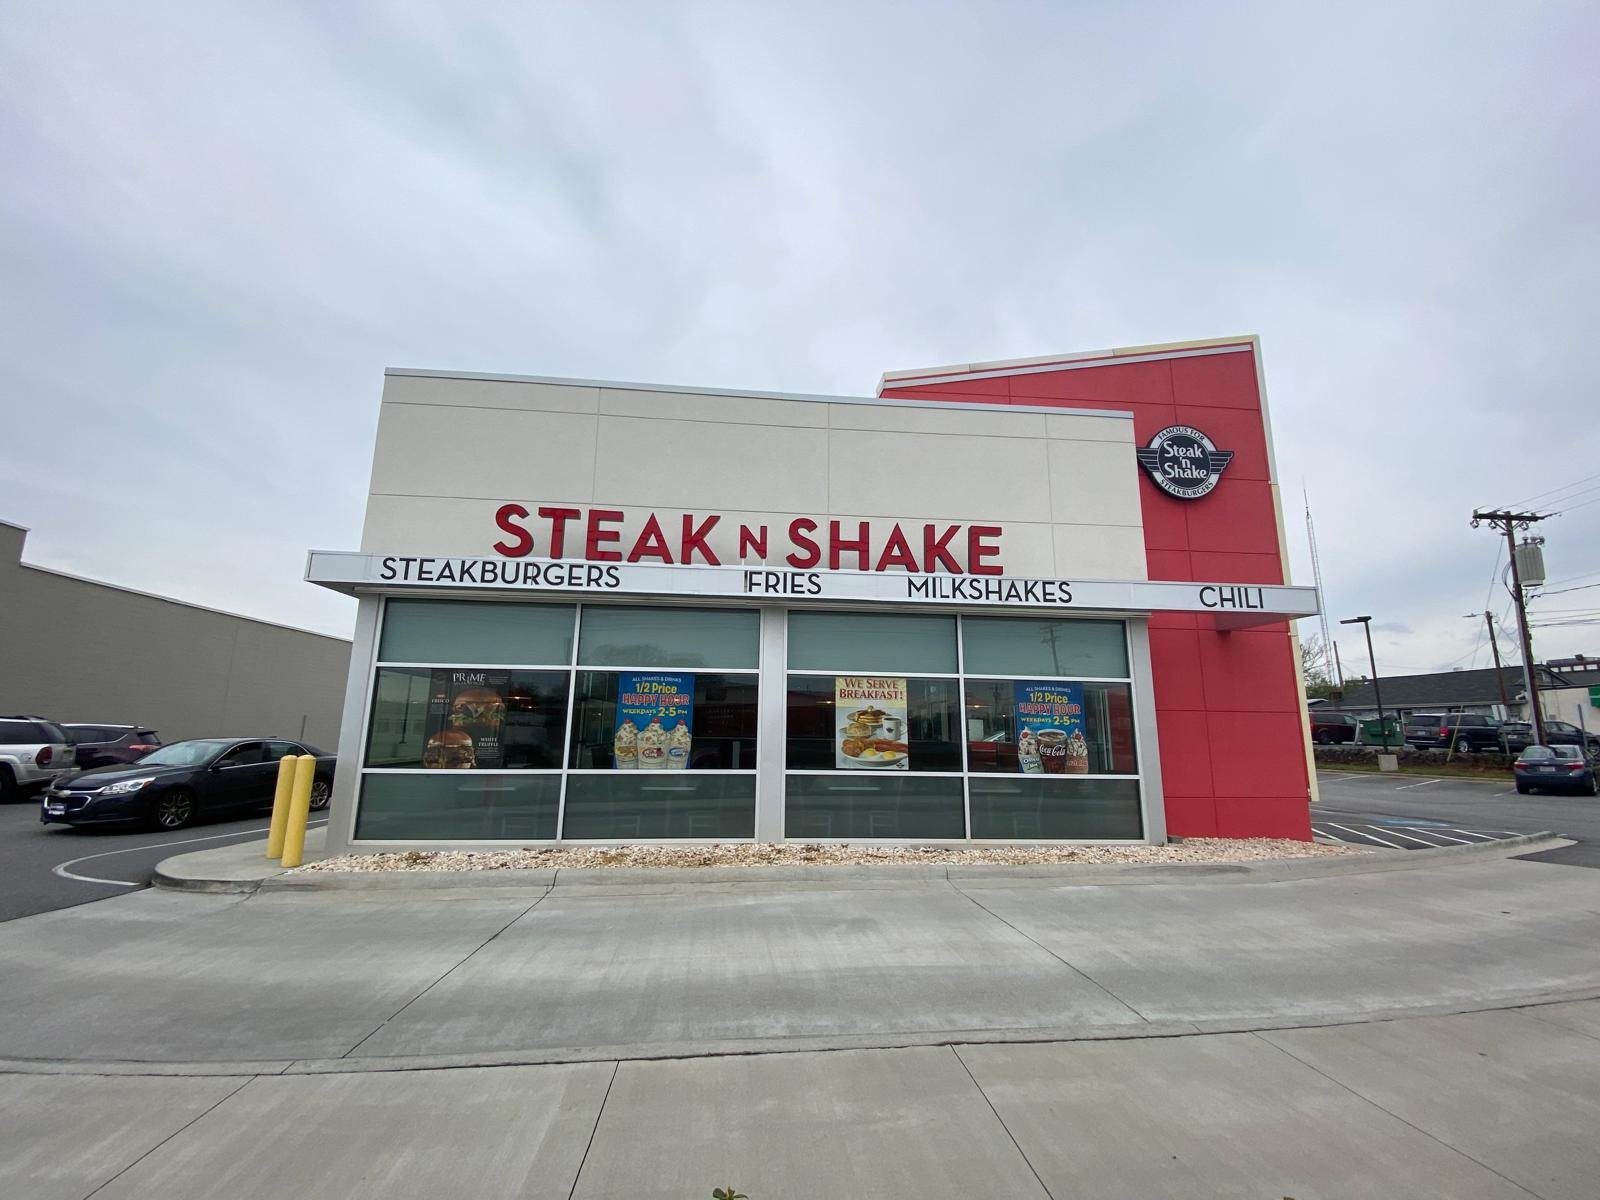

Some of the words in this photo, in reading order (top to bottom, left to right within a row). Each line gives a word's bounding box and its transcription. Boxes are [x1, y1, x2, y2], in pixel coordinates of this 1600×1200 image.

[1158, 427, 1189, 440] FAMOUS
[1190, 429, 1205, 441] FOR
[1163, 441, 1203, 458] Steak
[1164, 462, 1207, 479] Shake
[1160, 480, 1214, 497] STEAKBURGERS
[493, 503, 722, 566] STEAK
[739, 524, 768, 560] N
[786, 517, 1004, 576] SHAKE
[380, 557, 621, 588] STEAKBURGERS
[747, 571, 822, 595] FRIES
[907, 577, 1073, 604] MILKSHAKES
[1199, 586, 1264, 609] CHILI
[636, 682, 650, 693] 1/2
[652, 682, 678, 694] Price
[844, 678, 864, 689] WE
[866, 678, 899, 689] SERVE
[622, 693, 659, 706] HAPPY
[659, 693, 690, 706] HOUR
[839, 688, 904, 700] BREAKFAST!
[1029, 692, 1044, 702] 1/2
[1044, 692, 1069, 704] Price
[657, 706, 677, 717] 2-5
[1018, 703, 1052, 715] HAPPY
[1053, 703, 1081, 716] HOUR
[1053, 716, 1071, 725] 2-5
